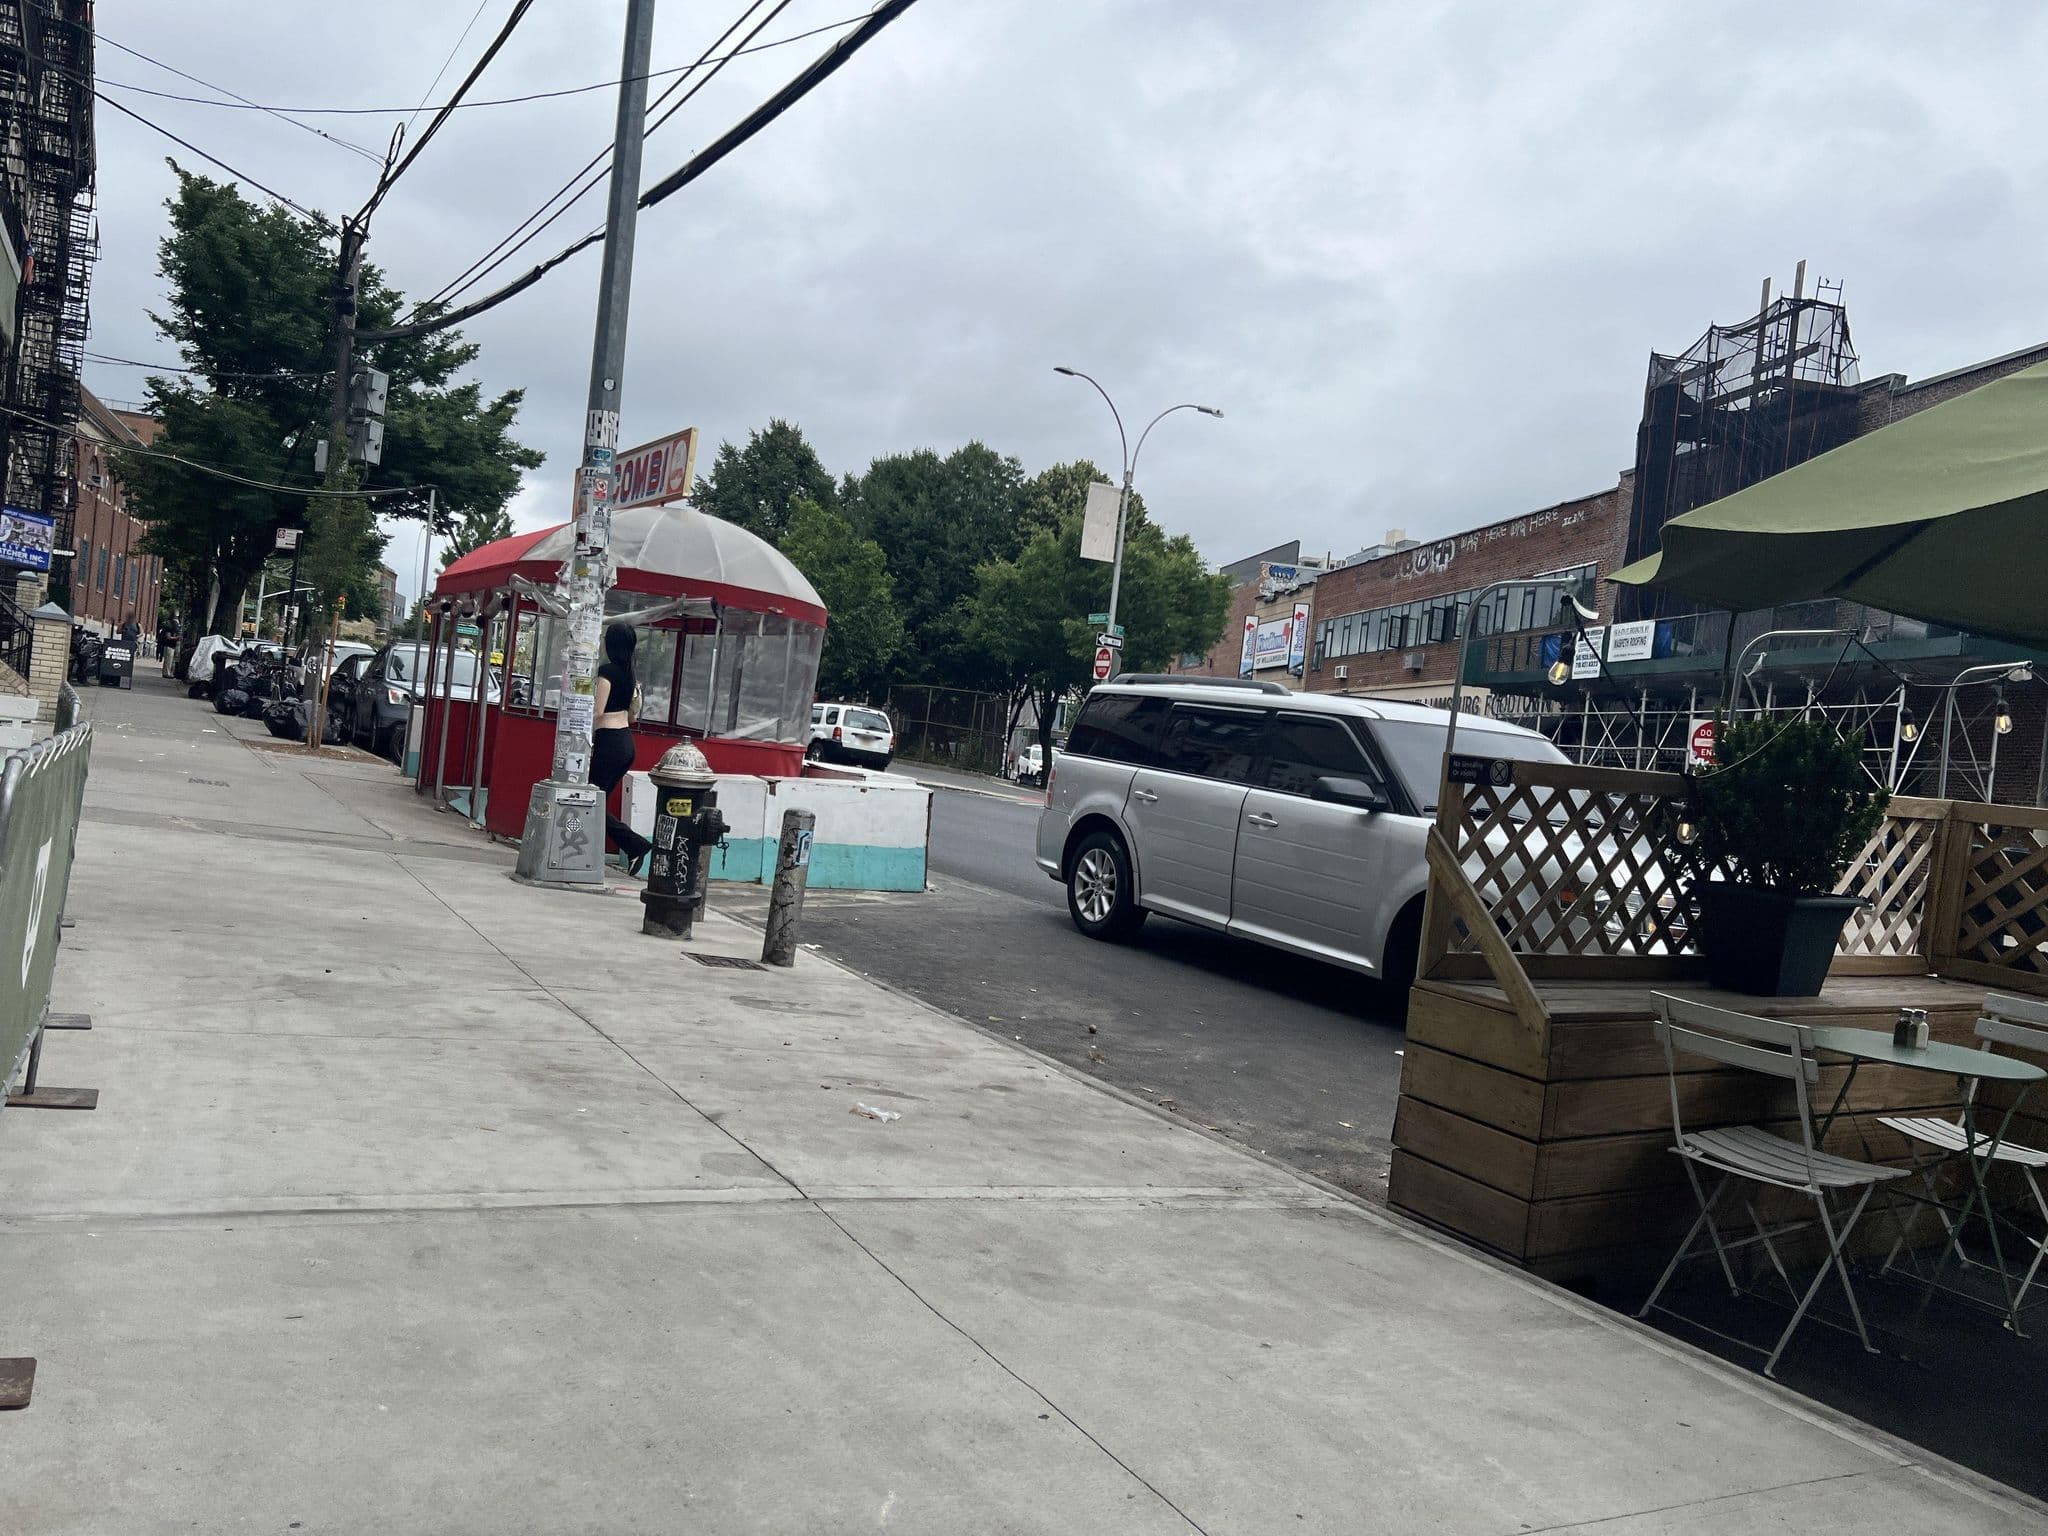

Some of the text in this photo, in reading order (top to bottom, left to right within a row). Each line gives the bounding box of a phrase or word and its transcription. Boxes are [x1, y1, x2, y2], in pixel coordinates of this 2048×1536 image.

[1484, 528, 1507, 543] HERE
[1529, 509, 1559, 532] HERE
[1700, 729, 1712, 737] DO
